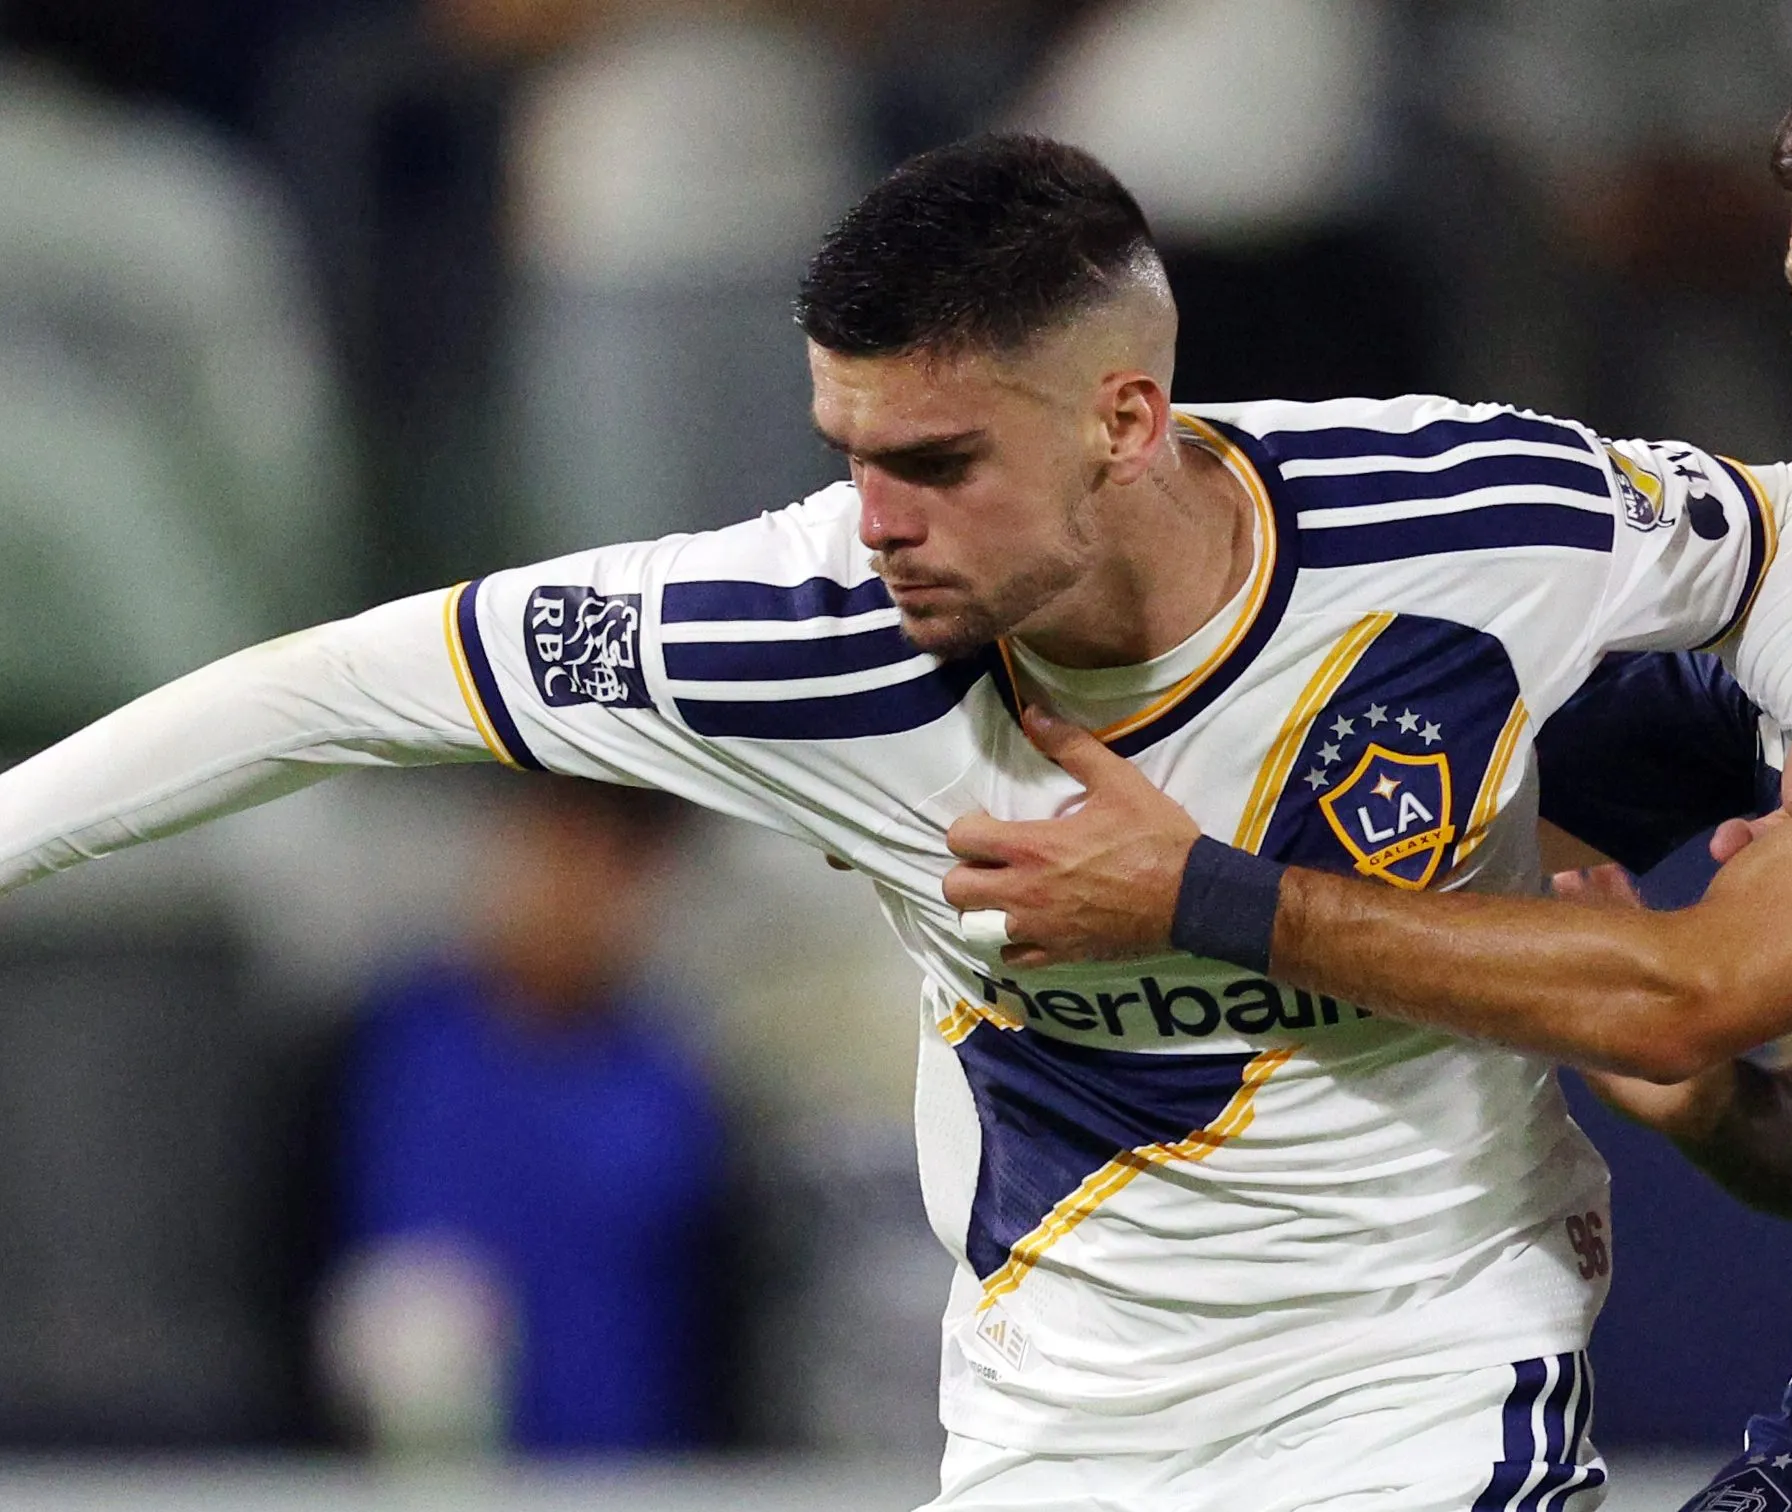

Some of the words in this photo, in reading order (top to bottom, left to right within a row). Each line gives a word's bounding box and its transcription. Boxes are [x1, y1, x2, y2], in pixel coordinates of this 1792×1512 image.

[532, 597, 575, 697] RBC
[1357, 791, 1434, 844] LA
[1369, 831, 1443, 867] GALAXY
[1565, 1210, 1610, 1281] 96
